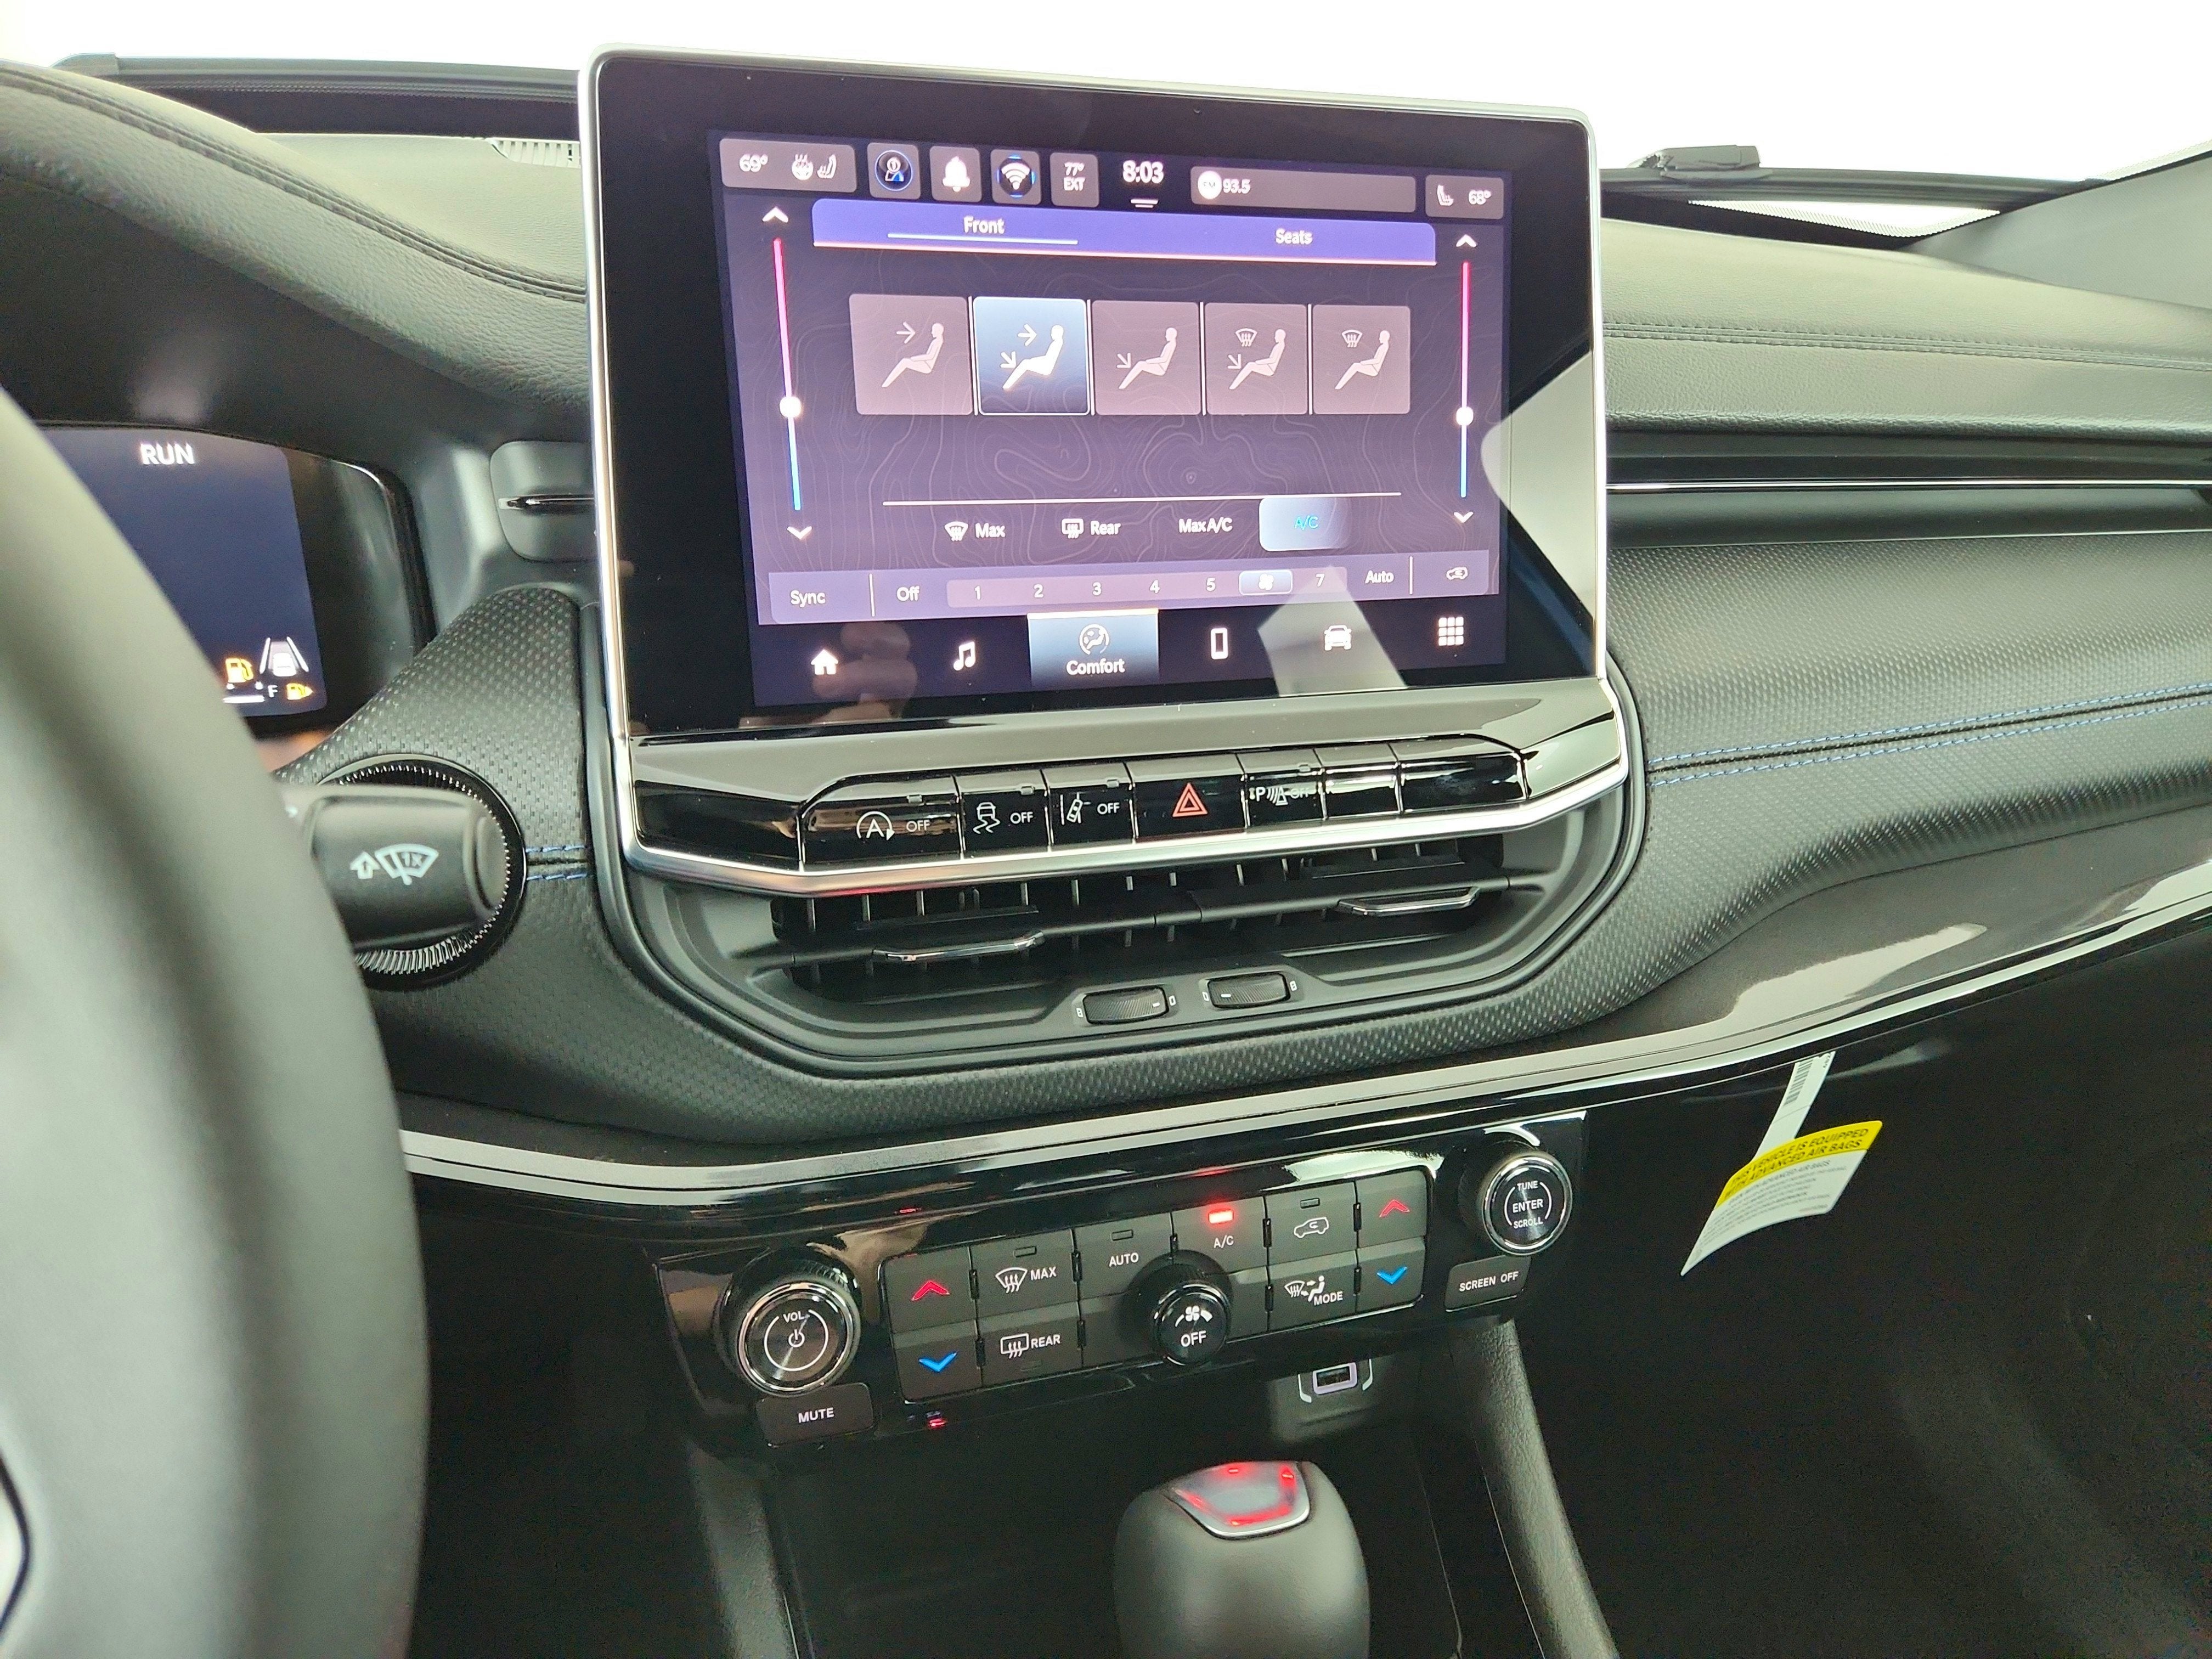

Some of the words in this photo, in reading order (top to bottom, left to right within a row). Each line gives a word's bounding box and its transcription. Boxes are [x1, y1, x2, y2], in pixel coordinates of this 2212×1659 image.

[739, 154, 768, 172] 69°
[1122, 160, 1164, 183] 8:03
[1063, 177, 1086, 191] EXT
[1223, 178, 1251, 194] 93.5
[1469, 189, 1491, 205] 68°
[963, 216, 1005, 234] Front
[1276, 228, 1313, 245] Seats
[140, 443, 195, 465] RUN
[975, 523, 1006, 538] Max
[1090, 521, 1121, 536] Rear
[1179, 518, 1206, 533] Max
[1206, 517, 1233, 533] A/C
[1294, 515, 1319, 531] A/C
[1365, 569, 1394, 584] Auto
[896, 586, 919, 602] Off
[974, 586, 981, 600] 1
[1034, 584, 1044, 598] 2
[1092, 582, 1102, 596] 3
[1149, 580, 1160, 593] 4
[1206, 578, 1216, 591] 5
[1316, 573, 1325, 587] 7
[790, 589, 826, 608] Sync
[1066, 658, 1125, 675] Comfort
[268, 685, 278, 698] F
[1097, 803, 1120, 815] OFF
[1010, 812, 1033, 824] OFF
[906, 820, 930, 833] OFF
[1809, 1128, 1869, 1147] EQUIPPED
[1807, 1146, 1829, 1158] AIR
[1829, 1139, 1863, 1152] BAGS
[1516, 1181, 1539, 1191] TUNE
[1512, 1198, 1544, 1210] ENTER
[1513, 1217, 1544, 1229] SCROLL
[1214, 1234, 1234, 1249] A/C
[1109, 1252, 1139, 1267] AUTO
[1030, 1266, 1057, 1281] MAX
[1459, 1276, 1496, 1292] SCREEN
[1500, 1271, 1519, 1284] OFF
[1313, 1290, 1344, 1306] MODE
[783, 1312, 804, 1323] VOL
[1030, 1334, 1061, 1349] REAR
[1181, 1330, 1206, 1348] OFF
[798, 1407, 834, 1423] MUTE
